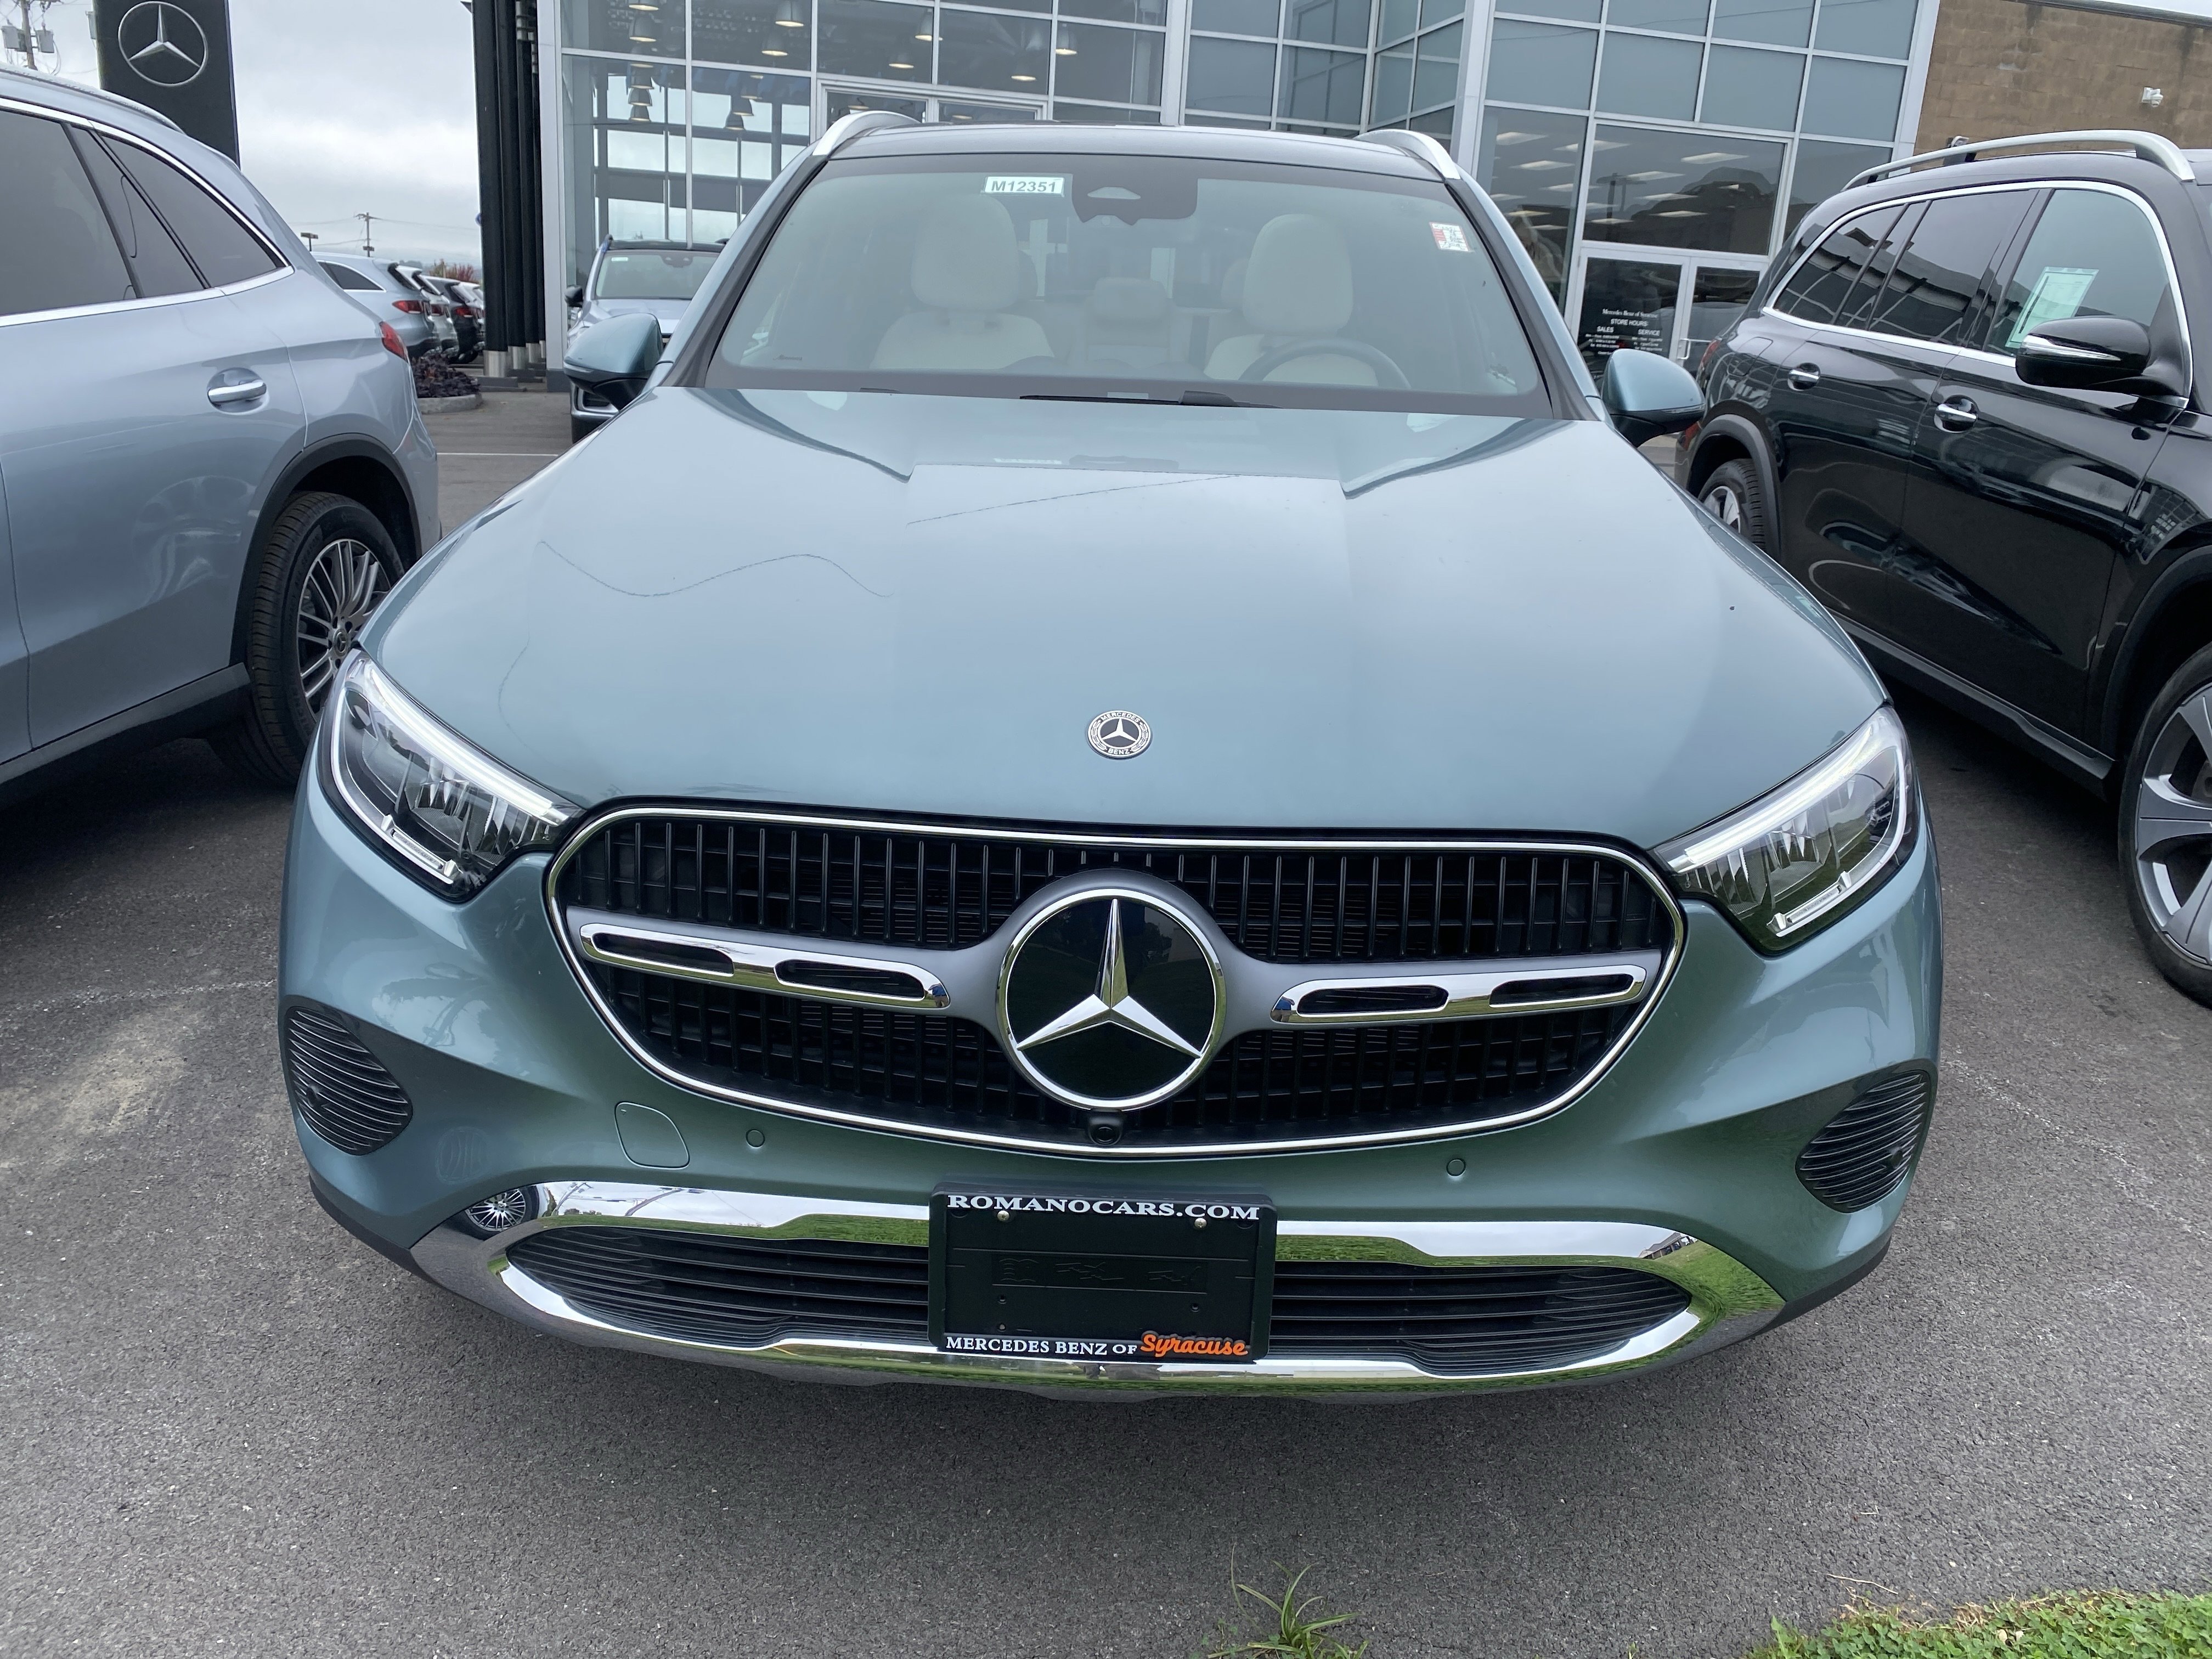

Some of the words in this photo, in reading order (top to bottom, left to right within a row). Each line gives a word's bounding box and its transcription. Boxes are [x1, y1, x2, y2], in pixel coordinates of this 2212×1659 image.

[991, 180, 1057, 193] M12351
[1100, 712, 1141, 723] MERCEDES
[946, 1195, 1260, 1220] ROMANOCARS.COM
[946, 1337, 1050, 1354] MERCEDES
[1055, 1341, 1108, 1356] BENZ
[1112, 1344, 1138, 1355] OF
[1141, 1334, 1249, 1358] Syracuse
